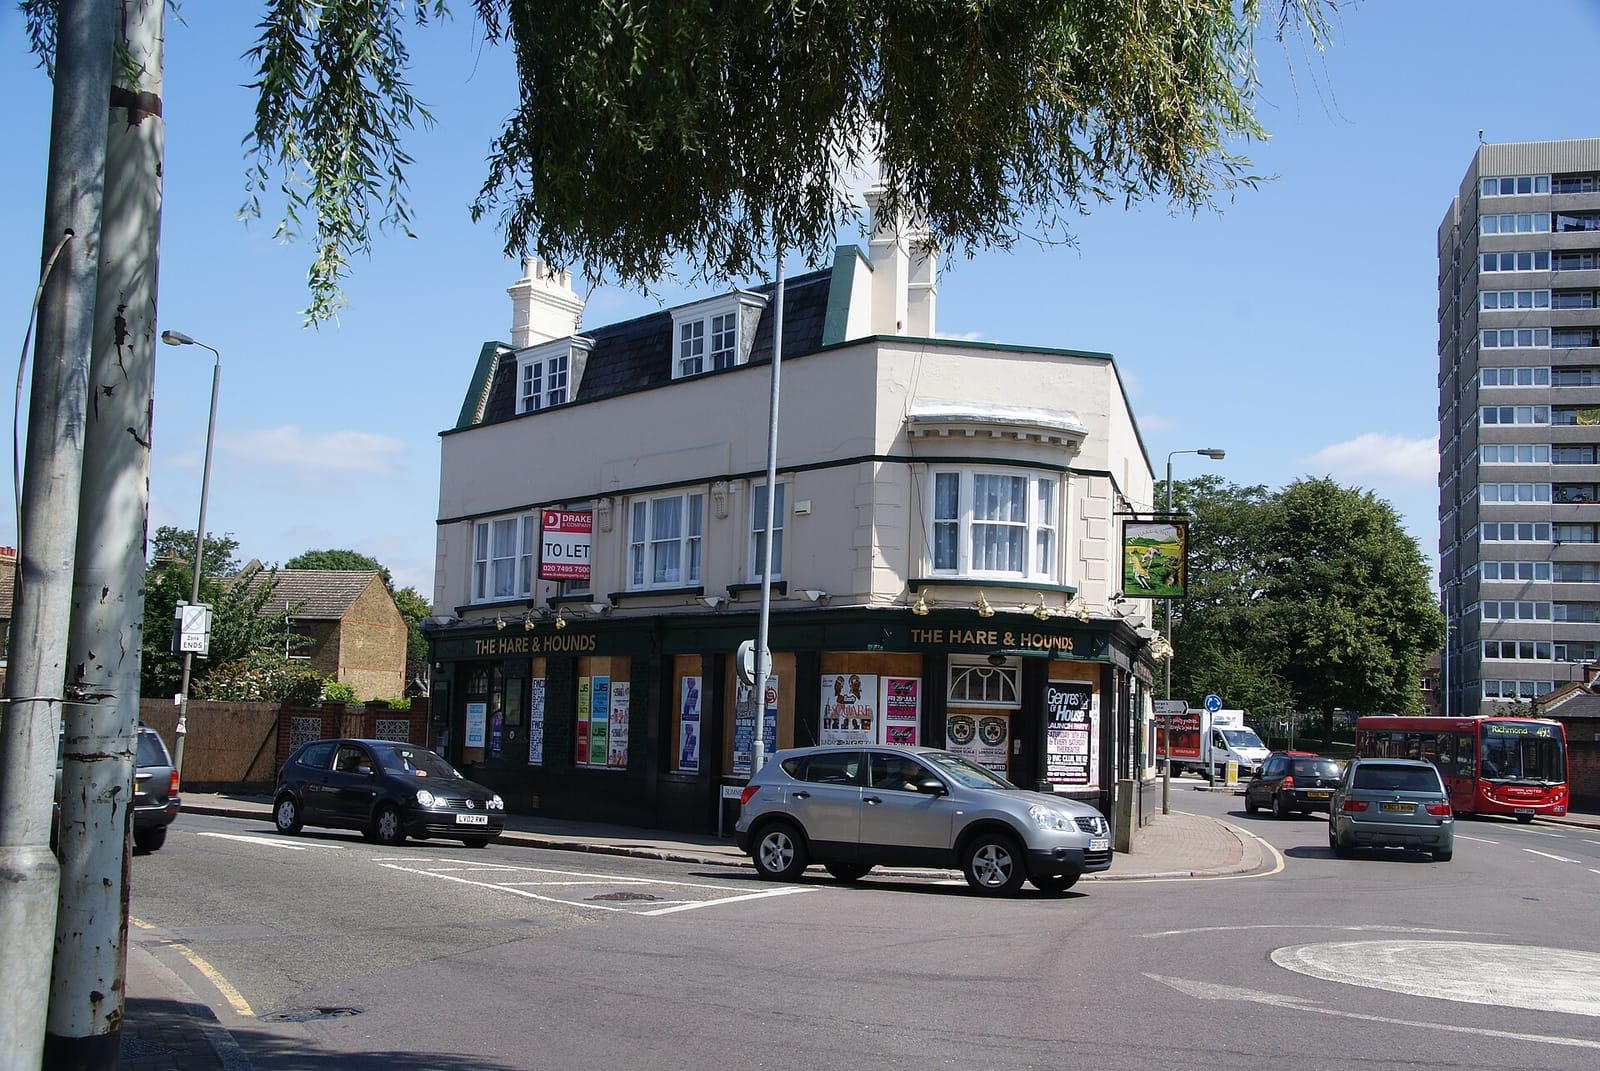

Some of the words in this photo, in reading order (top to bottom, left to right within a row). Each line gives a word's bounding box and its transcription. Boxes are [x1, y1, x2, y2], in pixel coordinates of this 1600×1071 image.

[562, 514, 592, 522] DRAKE
[545, 543, 562, 557] TO
[566, 544, 591, 558] LET
[475, 639, 496, 655] THE
[498, 637, 529, 654] HARE
[531, 636, 540, 652] &
[543, 635, 596, 651] HOUNDS
[911, 629, 943, 643] THE
[950, 631, 998, 645] HARE
[1003, 632, 1015, 646] &
[1020, 633, 1074, 649] HOUNDS
[1048, 687, 1079, 705] Genres
[1056, 705, 1085, 722] House
[1492, 725, 1528, 735] Richmond
[1536, 727, 1552, 738] 493
